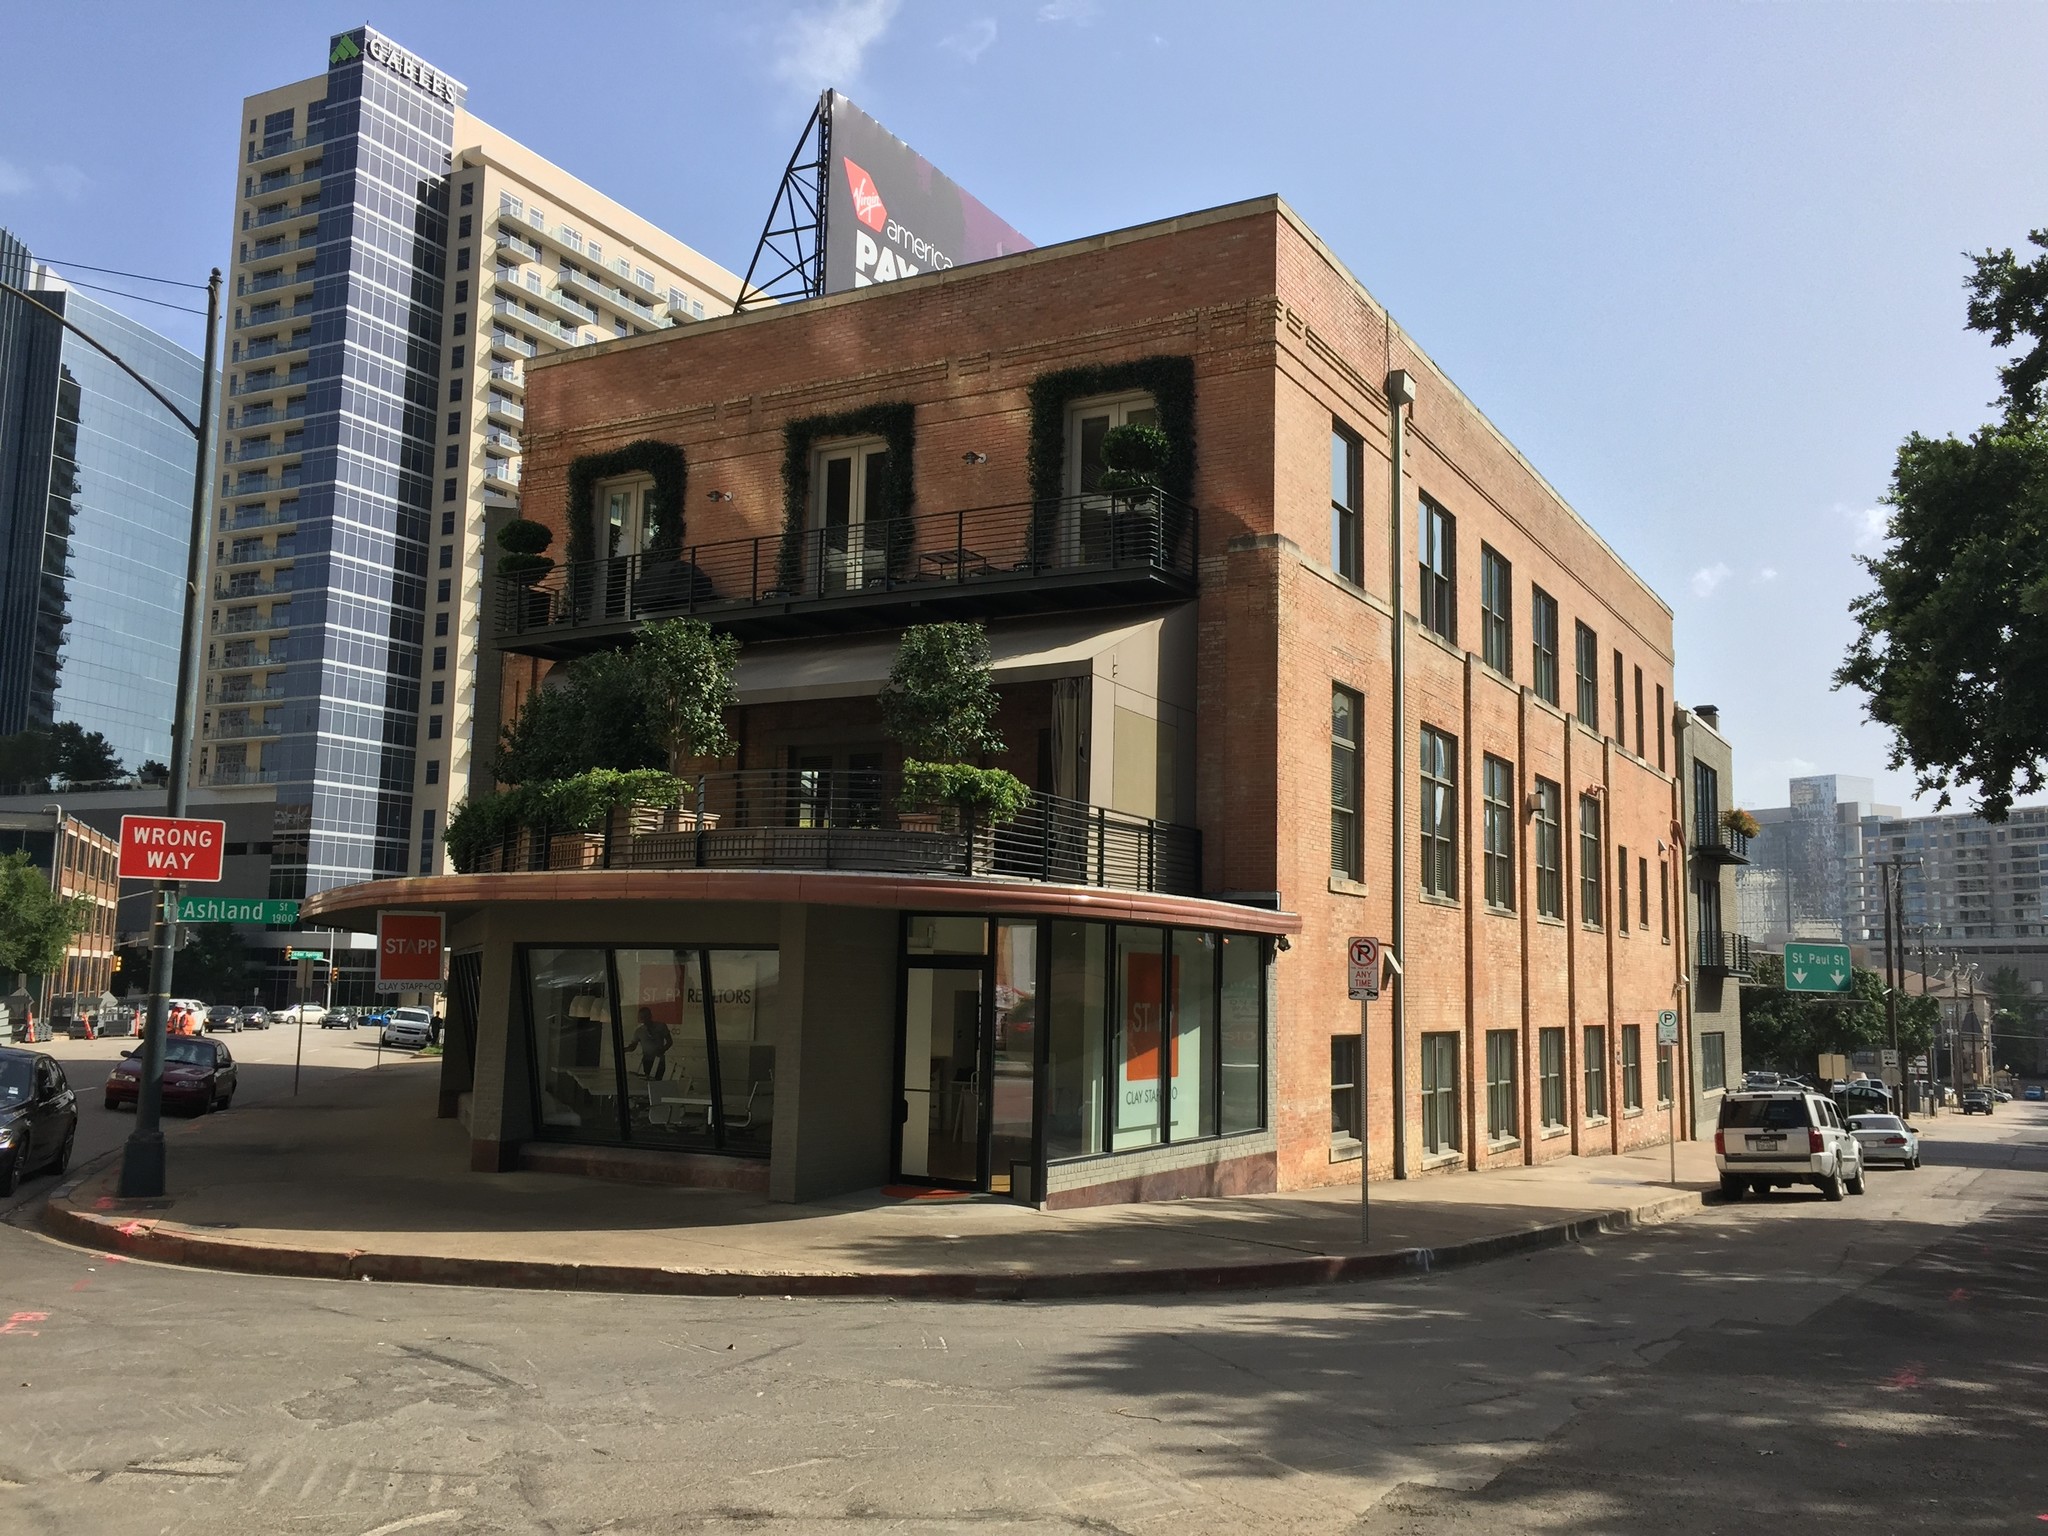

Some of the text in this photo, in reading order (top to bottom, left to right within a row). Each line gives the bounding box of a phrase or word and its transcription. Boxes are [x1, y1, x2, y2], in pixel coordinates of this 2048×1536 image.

[853, 177, 881, 223] Virgin
[887, 218, 954, 271] america
[856, 229, 919, 284] PAY
[133, 826, 212, 848] WRONG
[147, 851, 195, 870] WAY
[183, 900, 288, 920] Ashland St
[272, 913, 294, 923] 1900
[385, 937, 437, 954] STAPP
[1809, 953, 1830, 965] Paul
[1834, 954, 1844, 966] St
[1354, 979, 1372, 987] TIME
[1355, 970, 1373, 979] ANY
[377, 982, 441, 990] CLAY STAPP+CO
[642, 987, 751, 1004] STPP RELTORS
[1126, 1090, 1143, 1105] CLAY
